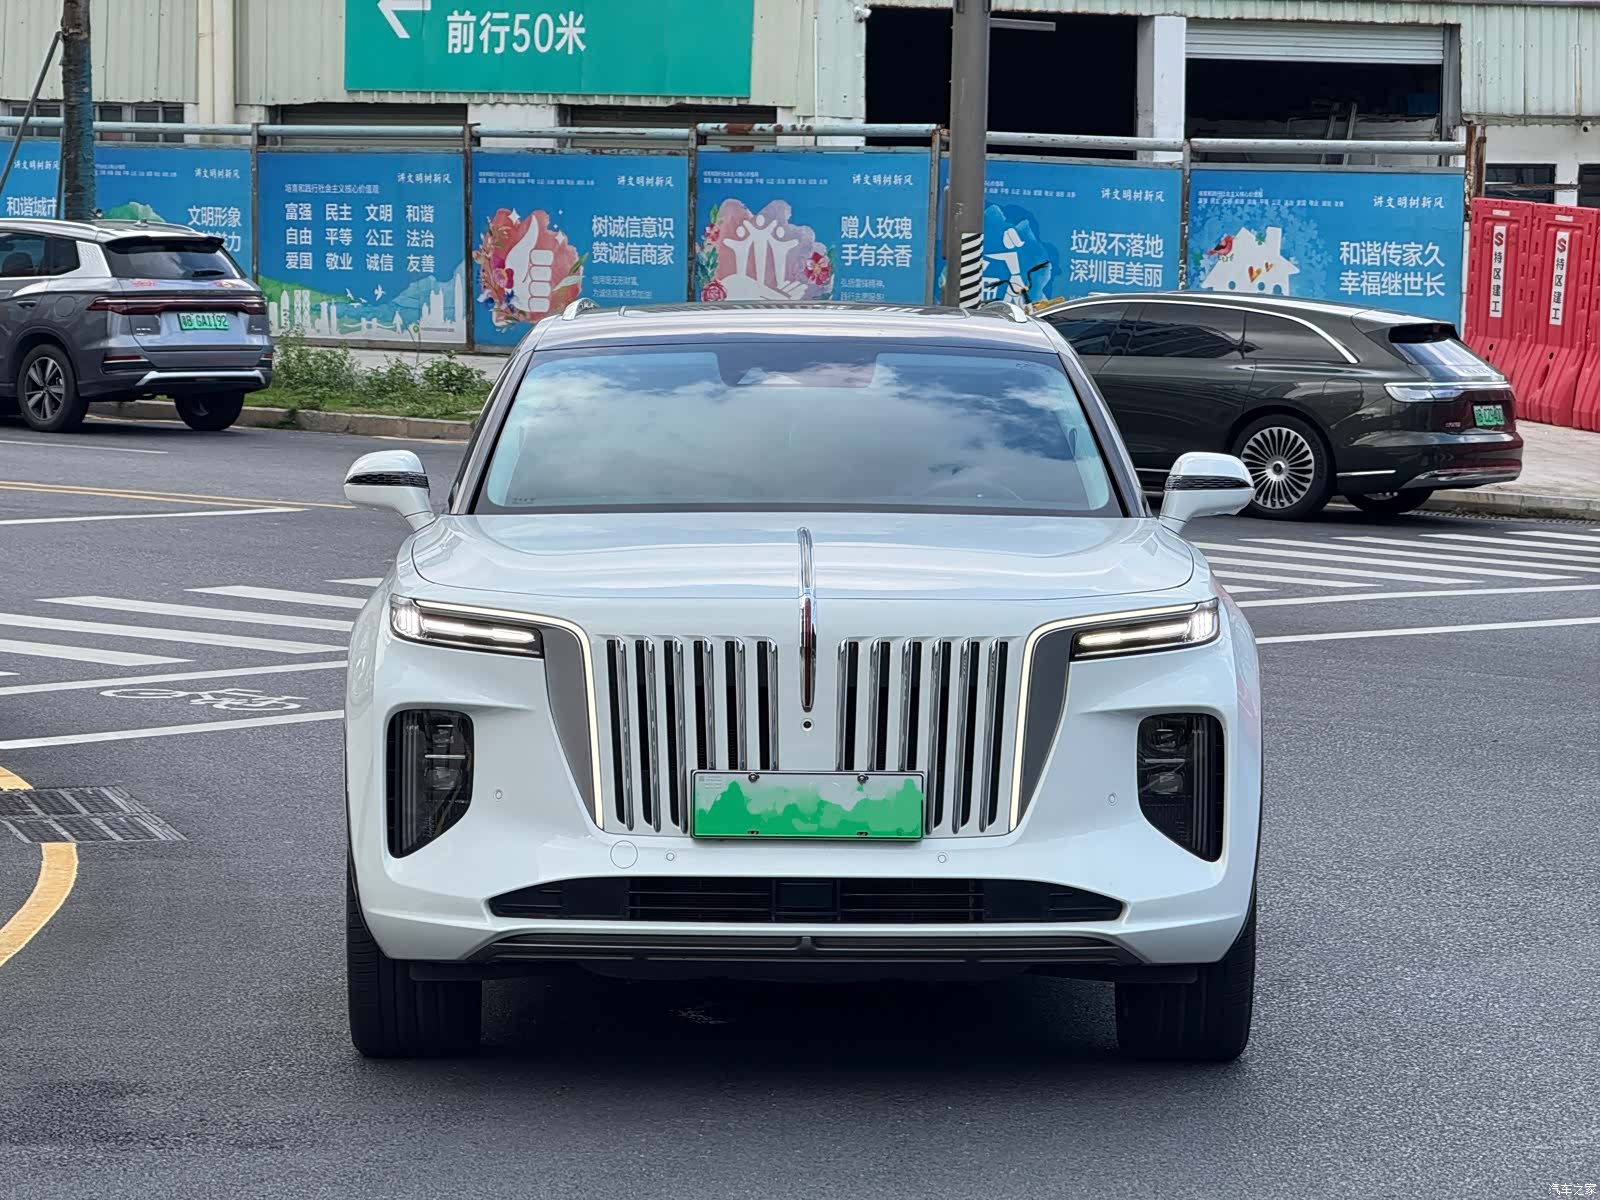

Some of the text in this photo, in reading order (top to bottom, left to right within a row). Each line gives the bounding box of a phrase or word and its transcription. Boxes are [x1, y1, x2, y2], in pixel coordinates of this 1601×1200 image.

[446, 10, 587, 55] 前行50米
[14, 159, 60, 170] 讲文明树新风
[194, 167, 241, 179] 讲文明树新风
[397, 172, 452, 184] 讲文明树新风
[617, 175, 675, 188] 讲文明树新风
[852, 173, 914, 186] 讲文明树新风
[1101, 187, 1165, 202] 讲文明树新风
[1373, 195, 1445, 209] 讲文明树新风
[187, 205, 242, 228] 文明形象
[284, 203, 435, 223] 富强 民主 文明 和谐
[285, 227, 435, 248] 自由 平等 公正 法治
[591, 215, 675, 239] 树诚信意识
[840, 215, 913, 240] 赠人玫瑰
[591, 242, 675, 266] 赞诚信商家
[1070, 230, 1165, 258] 垃圾不落地
[1339, 240, 1446, 268] 和谐传家久
[285, 252, 436, 273] 爱国 敬业 诚信 友善
[840, 243, 913, 268] 手有余香
[1069, 258, 1164, 288] 深圳更美丽
[1339, 269, 1446, 298] 幸福继世长
